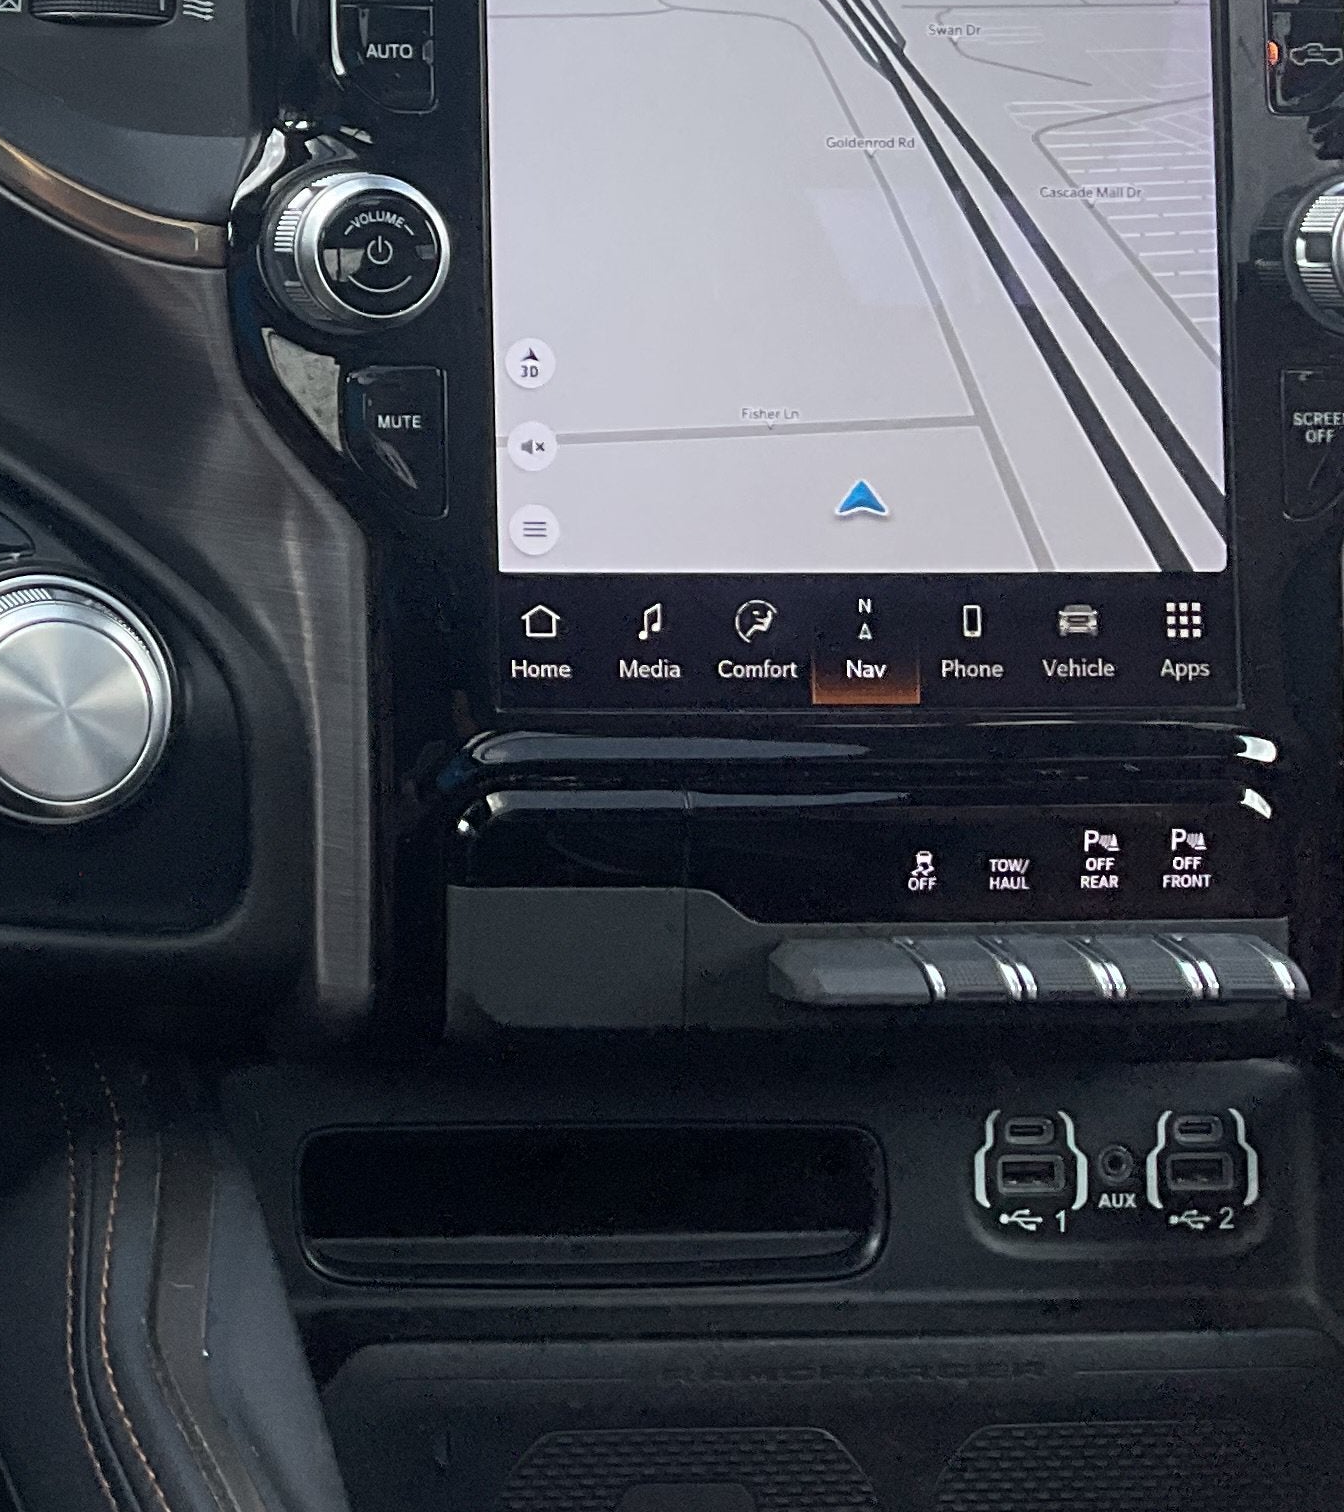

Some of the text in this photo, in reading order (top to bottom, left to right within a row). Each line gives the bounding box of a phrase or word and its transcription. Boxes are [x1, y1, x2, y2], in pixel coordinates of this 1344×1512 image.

[928, 25, 981, 36] Swan Dr
[364, 41, 413, 58] AUTO
[826, 136, 915, 150] Goldenrod Rd
[1040, 186, 1141, 199] Cascade Mall Dr
[350, 211, 405, 229] VOLUME
[521, 365, 538, 377] 3D
[741, 407, 799, 419] Fisher Ln
[1294, 412, 1344, 426] SCREE
[378, 415, 421, 428] MUTE
[1305, 428, 1334, 443] OFF
[859, 599, 871, 613] N
[512, 660, 571, 678] Home
[620, 659, 680, 678] Media
[718, 659, 798, 678] Comfort
[847, 660, 886, 678] Nav
[942, 659, 1003, 678] Phone
[1042, 658, 1114, 677] Vehicle
[1161, 659, 1210, 681] Apps
[989, 859, 1030, 874] TOW/
[1086, 857, 1115, 871] OFF
[1173, 857, 1202, 870] OFF
[908, 876, 936, 890] OFF
[990, 877, 1029, 889] HAUL
[1081, 875, 1118, 888] REAR
[1163, 874, 1211, 888] FRONT
[1098, 1193, 1137, 1208] AUX
[1056, 1210, 1065, 1232] 1
[1219, 1207, 1234, 1229] 2
